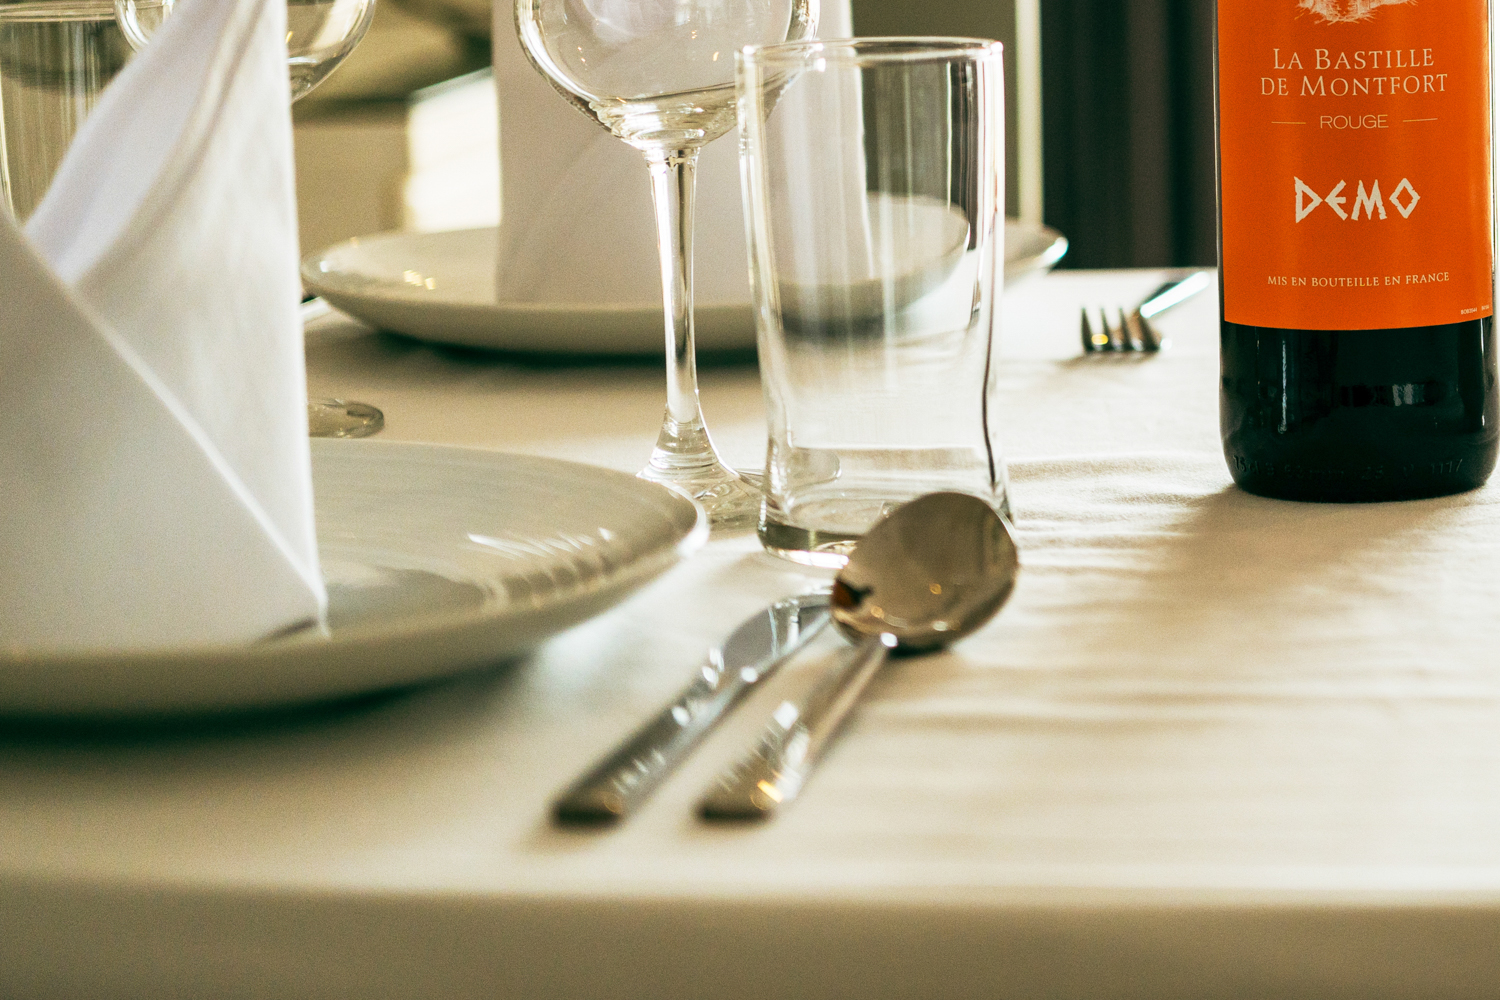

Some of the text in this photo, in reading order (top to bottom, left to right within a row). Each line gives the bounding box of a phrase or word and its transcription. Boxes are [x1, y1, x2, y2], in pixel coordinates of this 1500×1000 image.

[1273, 48, 1435, 70] LA BASTILLE
[1260, 73, 1448, 97] DE MONTFORT
[1319, 114, 1389, 130] ROUGE
[1293, 175, 1421, 224] DEMO
[1267, 271, 1450, 288] MIS EN BOUTEILLE EN FRANCE
